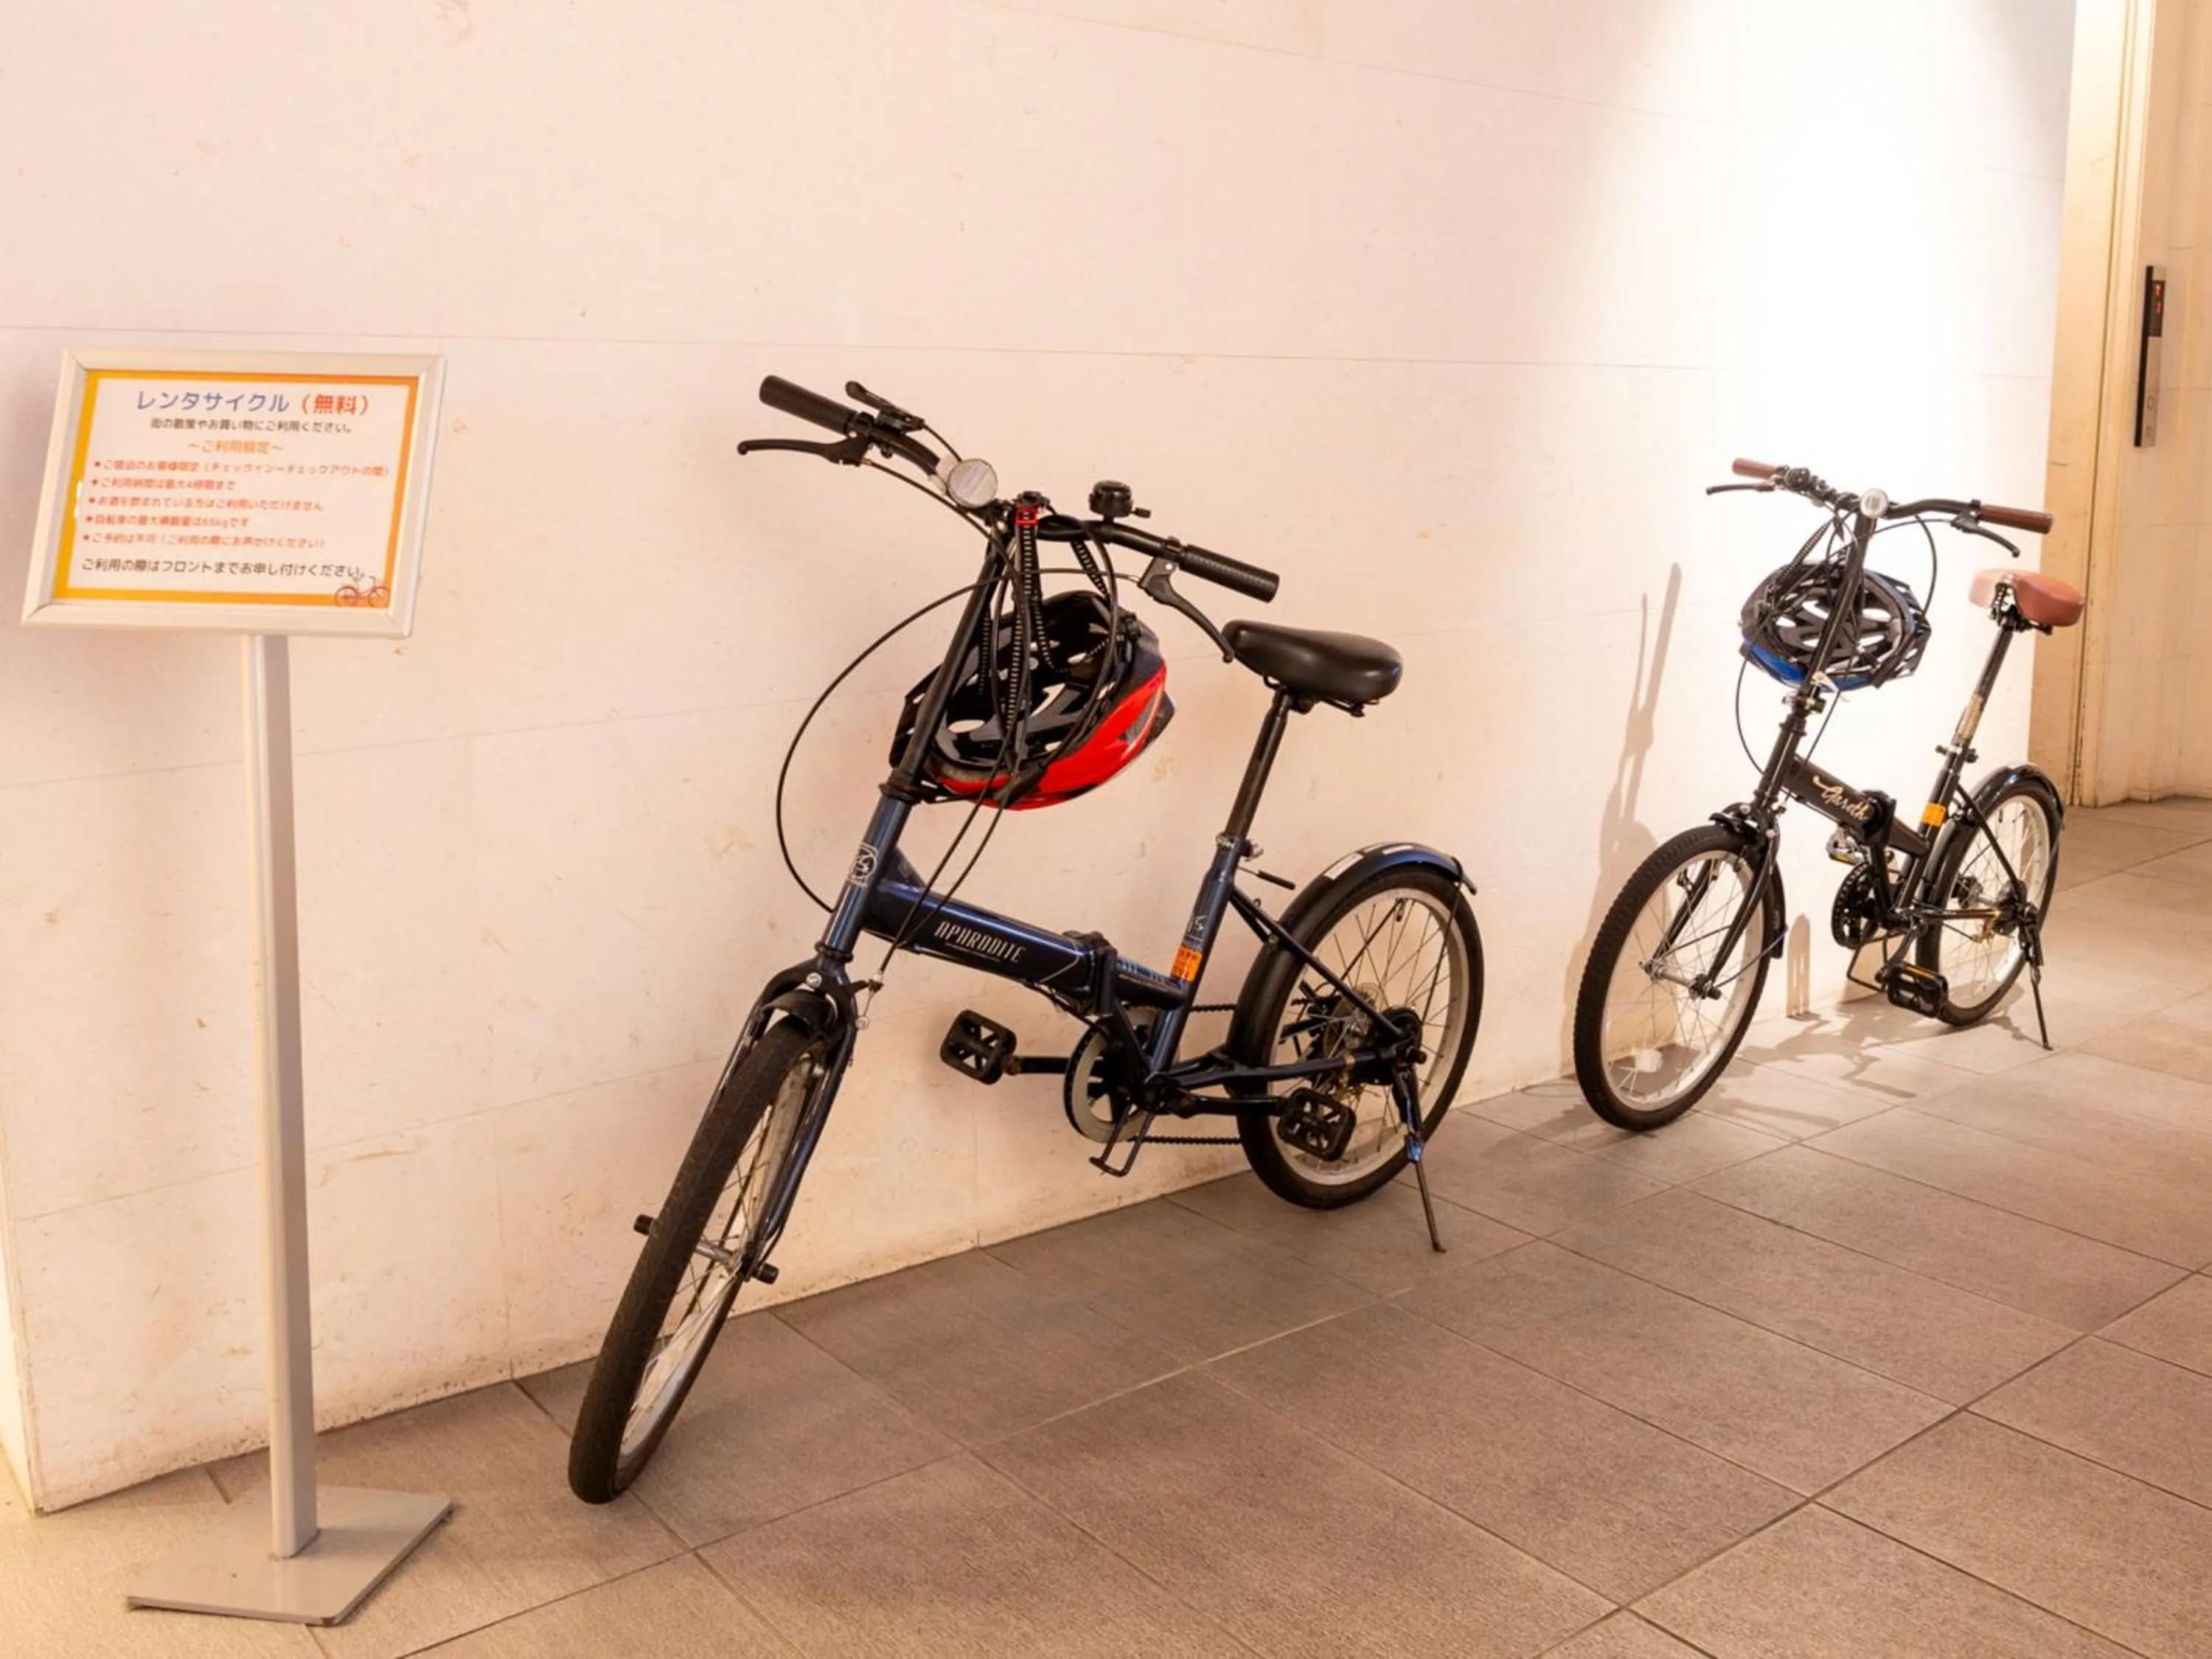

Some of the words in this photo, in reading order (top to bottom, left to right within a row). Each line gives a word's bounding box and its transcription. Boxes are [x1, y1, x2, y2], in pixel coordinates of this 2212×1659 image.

[137, 390, 369, 415] レンタサイクル（無料）
[933, 921, 1026, 964] APHRODITE
